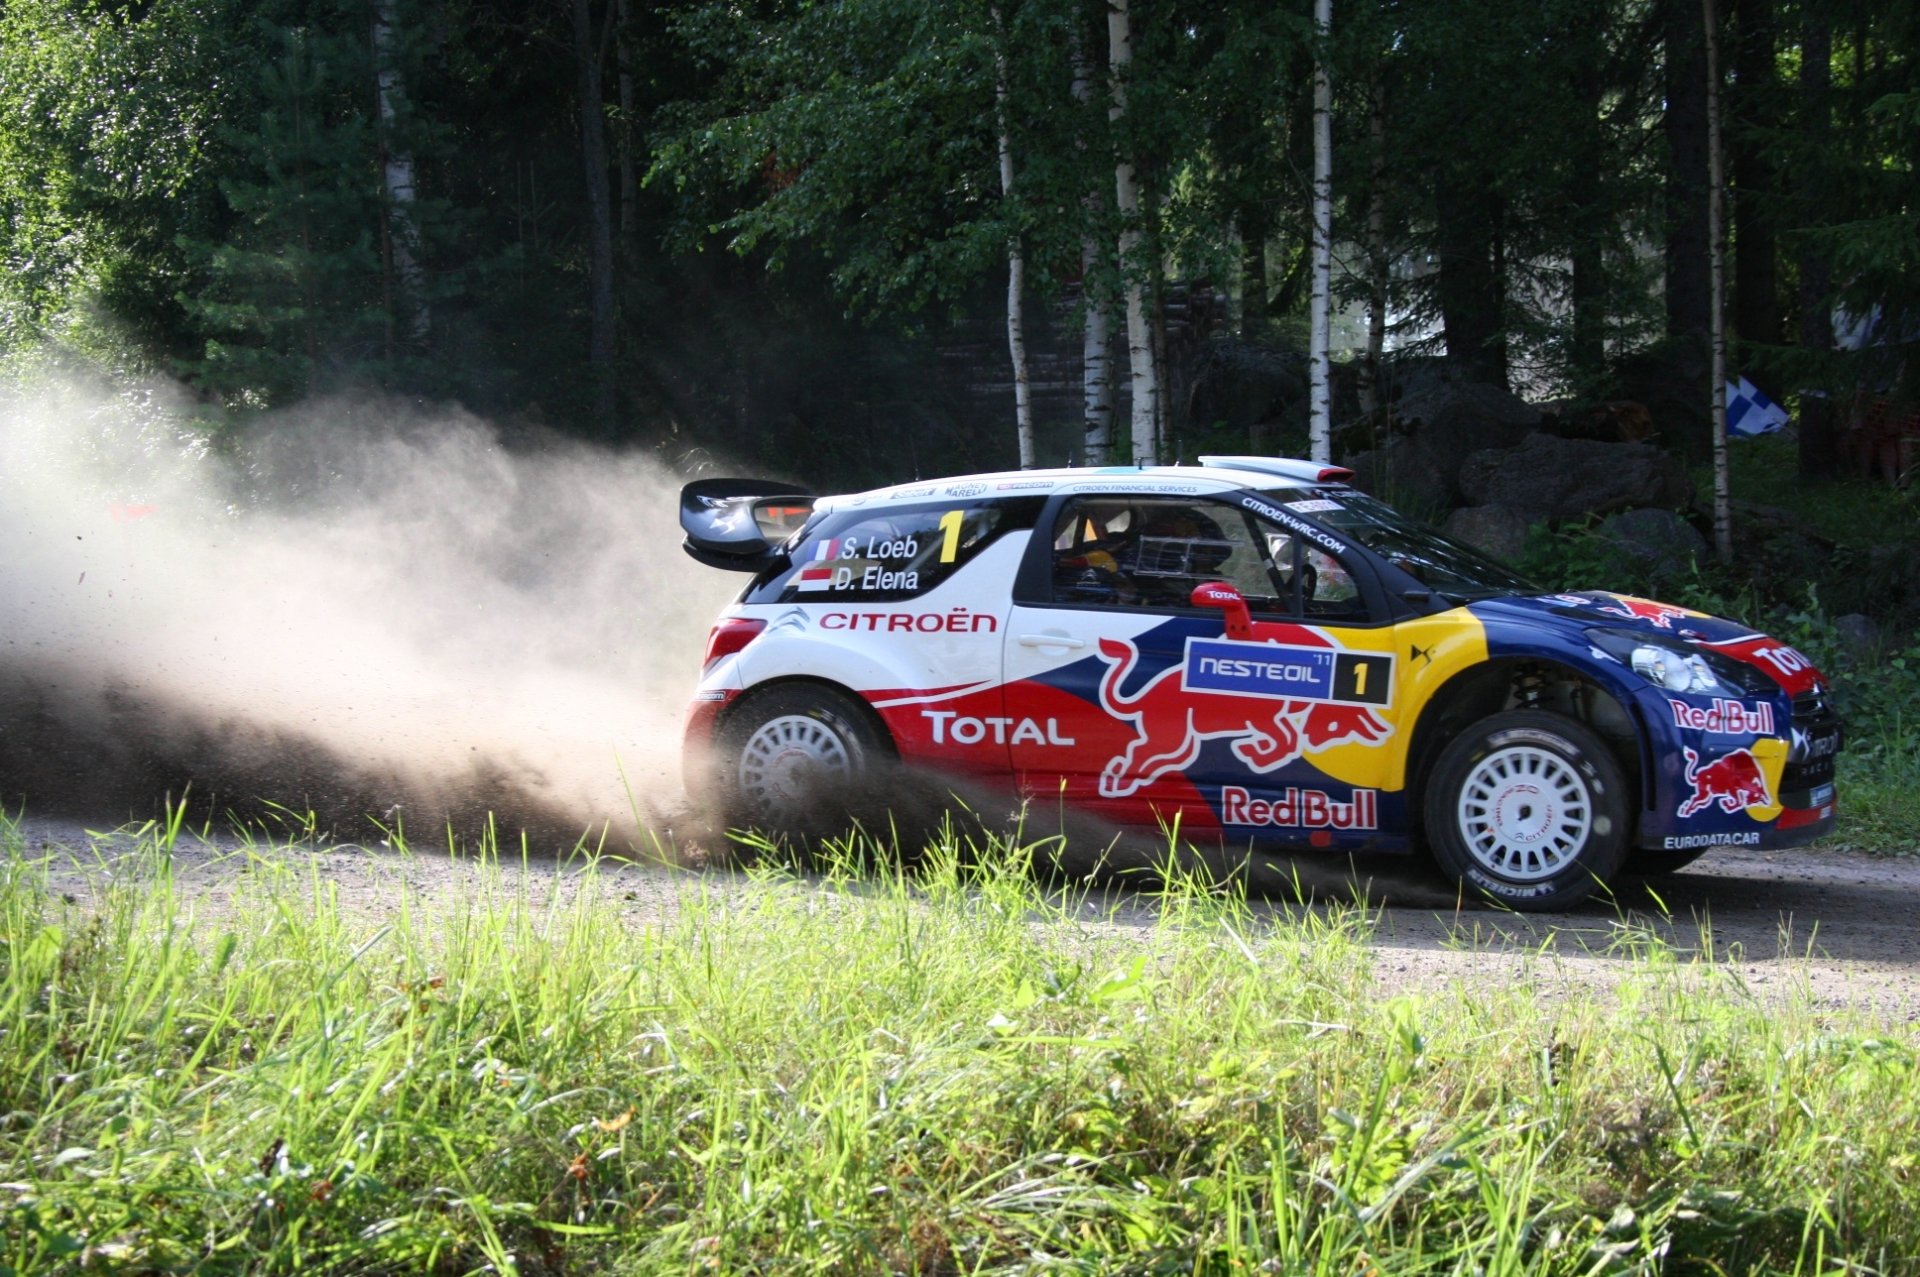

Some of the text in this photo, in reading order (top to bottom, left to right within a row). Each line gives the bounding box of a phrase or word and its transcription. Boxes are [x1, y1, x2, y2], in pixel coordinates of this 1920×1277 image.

[1159, 485, 1198, 493] SERVICES
[938, 510, 965, 563] 1
[1241, 497, 1346, 554] CITROEN-WRC.COM
[842, 536, 918, 559] S. Loeb
[834, 566, 918, 590] D. Elena
[1206, 590, 1241, 600] TOTAL
[1353, 662, 1369, 695] 1
[921, 710, 1075, 746] TOTAL
[1668, 699, 1775, 735] Red Bull
[1221, 785, 1378, 830] Red Bull
[1664, 831, 1760, 849] EURODATACAR
